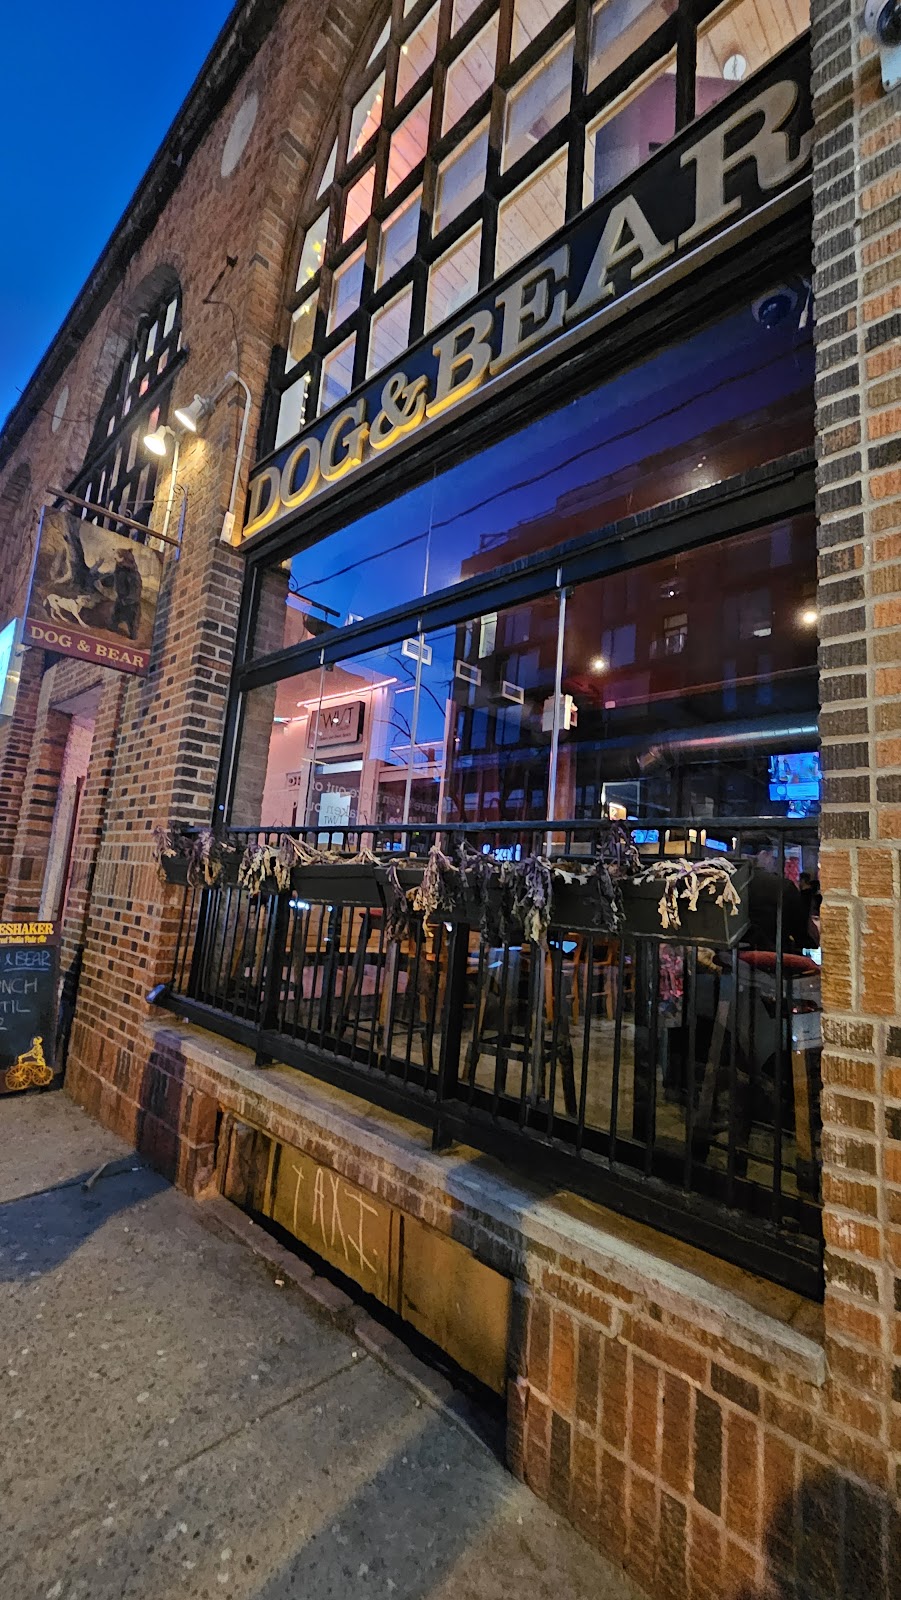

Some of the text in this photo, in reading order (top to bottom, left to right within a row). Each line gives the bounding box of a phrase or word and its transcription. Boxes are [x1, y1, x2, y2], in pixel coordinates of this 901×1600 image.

[243, 79, 811, 537] DOG & BEAR
[31, 626, 144, 667] DOG & BEAR
[15, 950, 51, 967] BEAR
